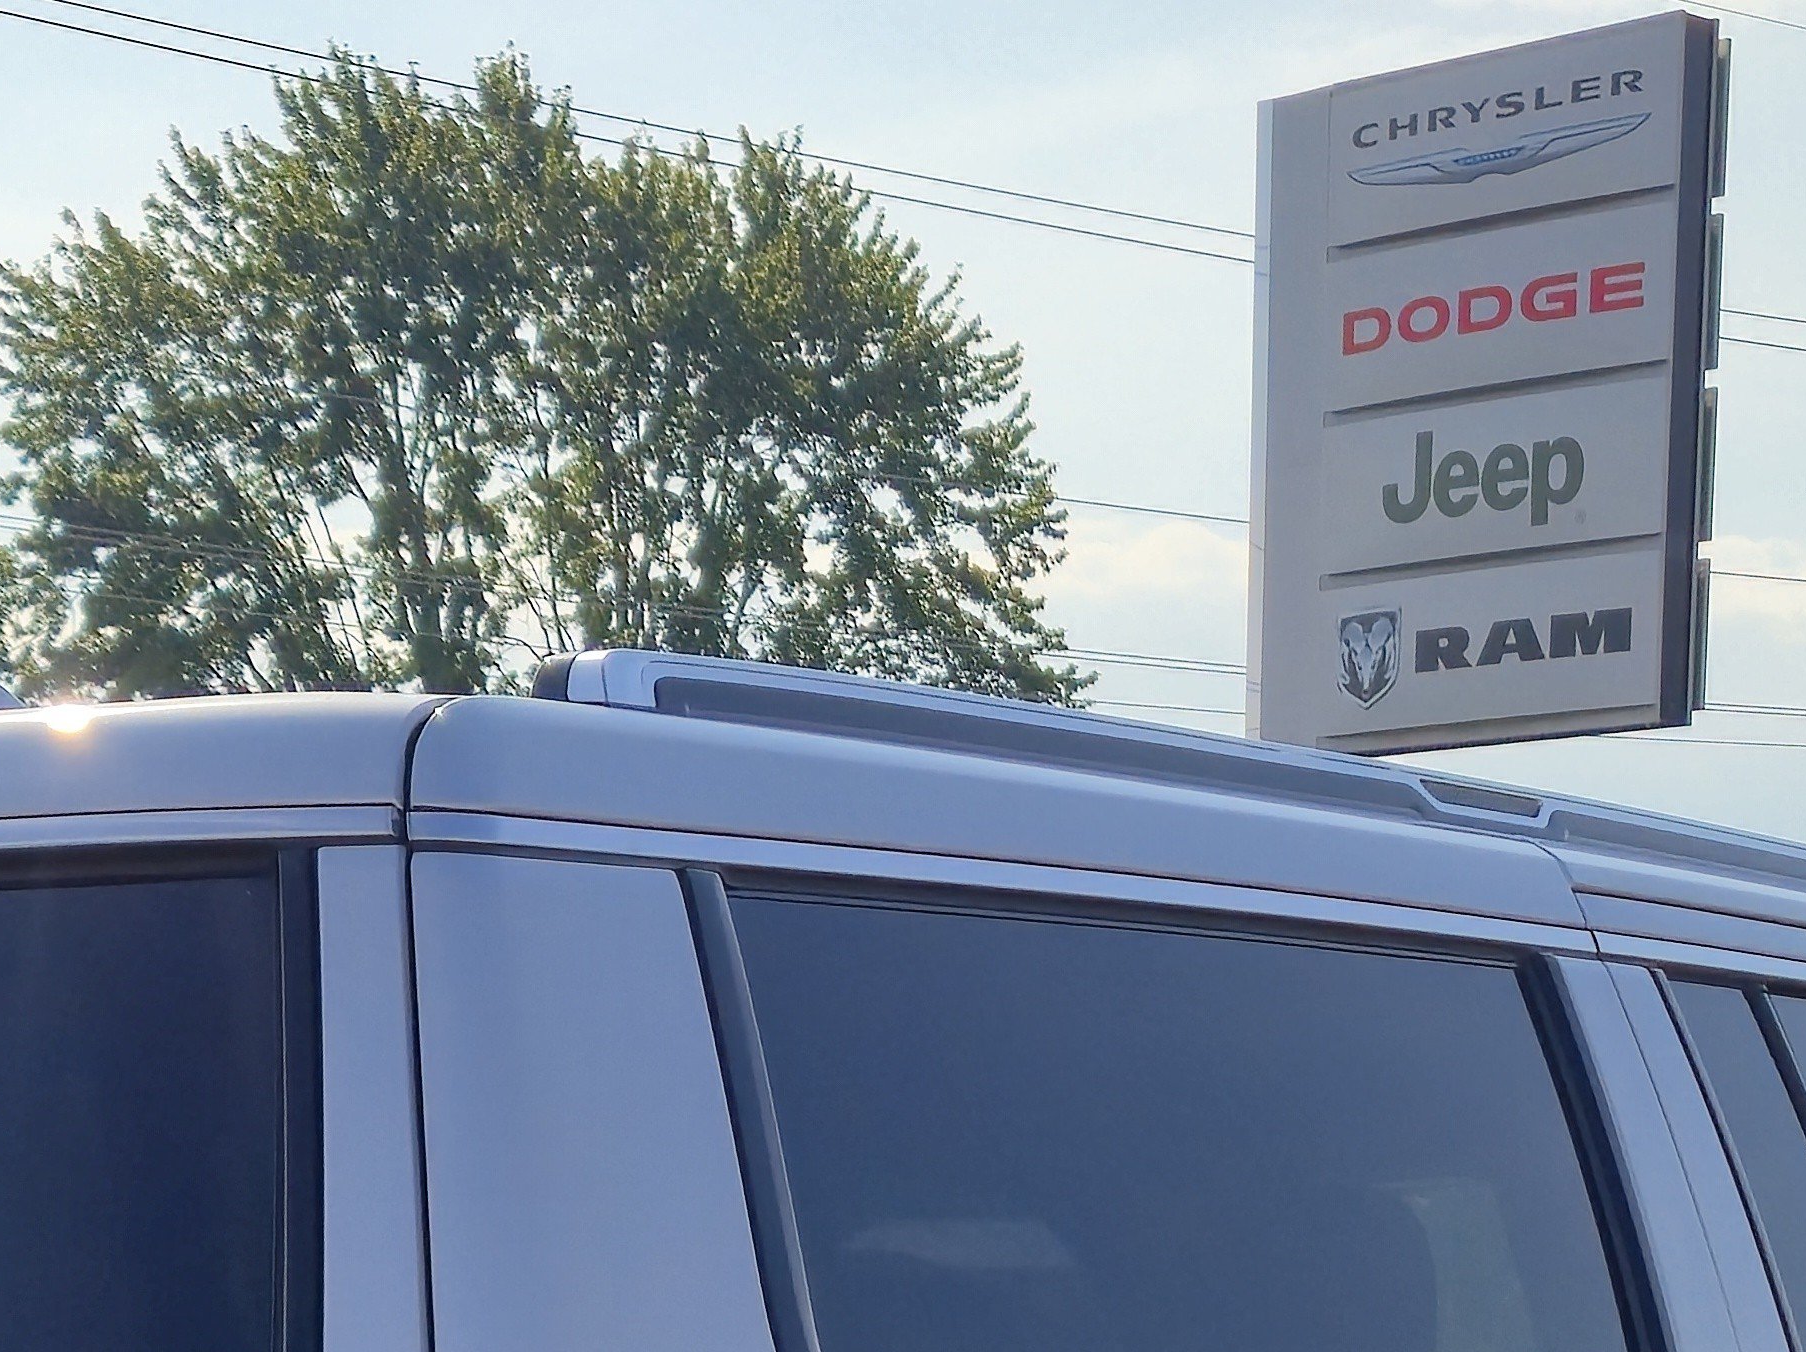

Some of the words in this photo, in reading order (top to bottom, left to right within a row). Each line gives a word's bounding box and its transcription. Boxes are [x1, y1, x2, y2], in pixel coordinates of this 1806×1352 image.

[1352, 68, 1645, 149] CHRYSLER
[1342, 261, 1647, 357] DODGE
[1381, 430, 1585, 527] Jeep
[1414, 606, 1633, 674] RAM
